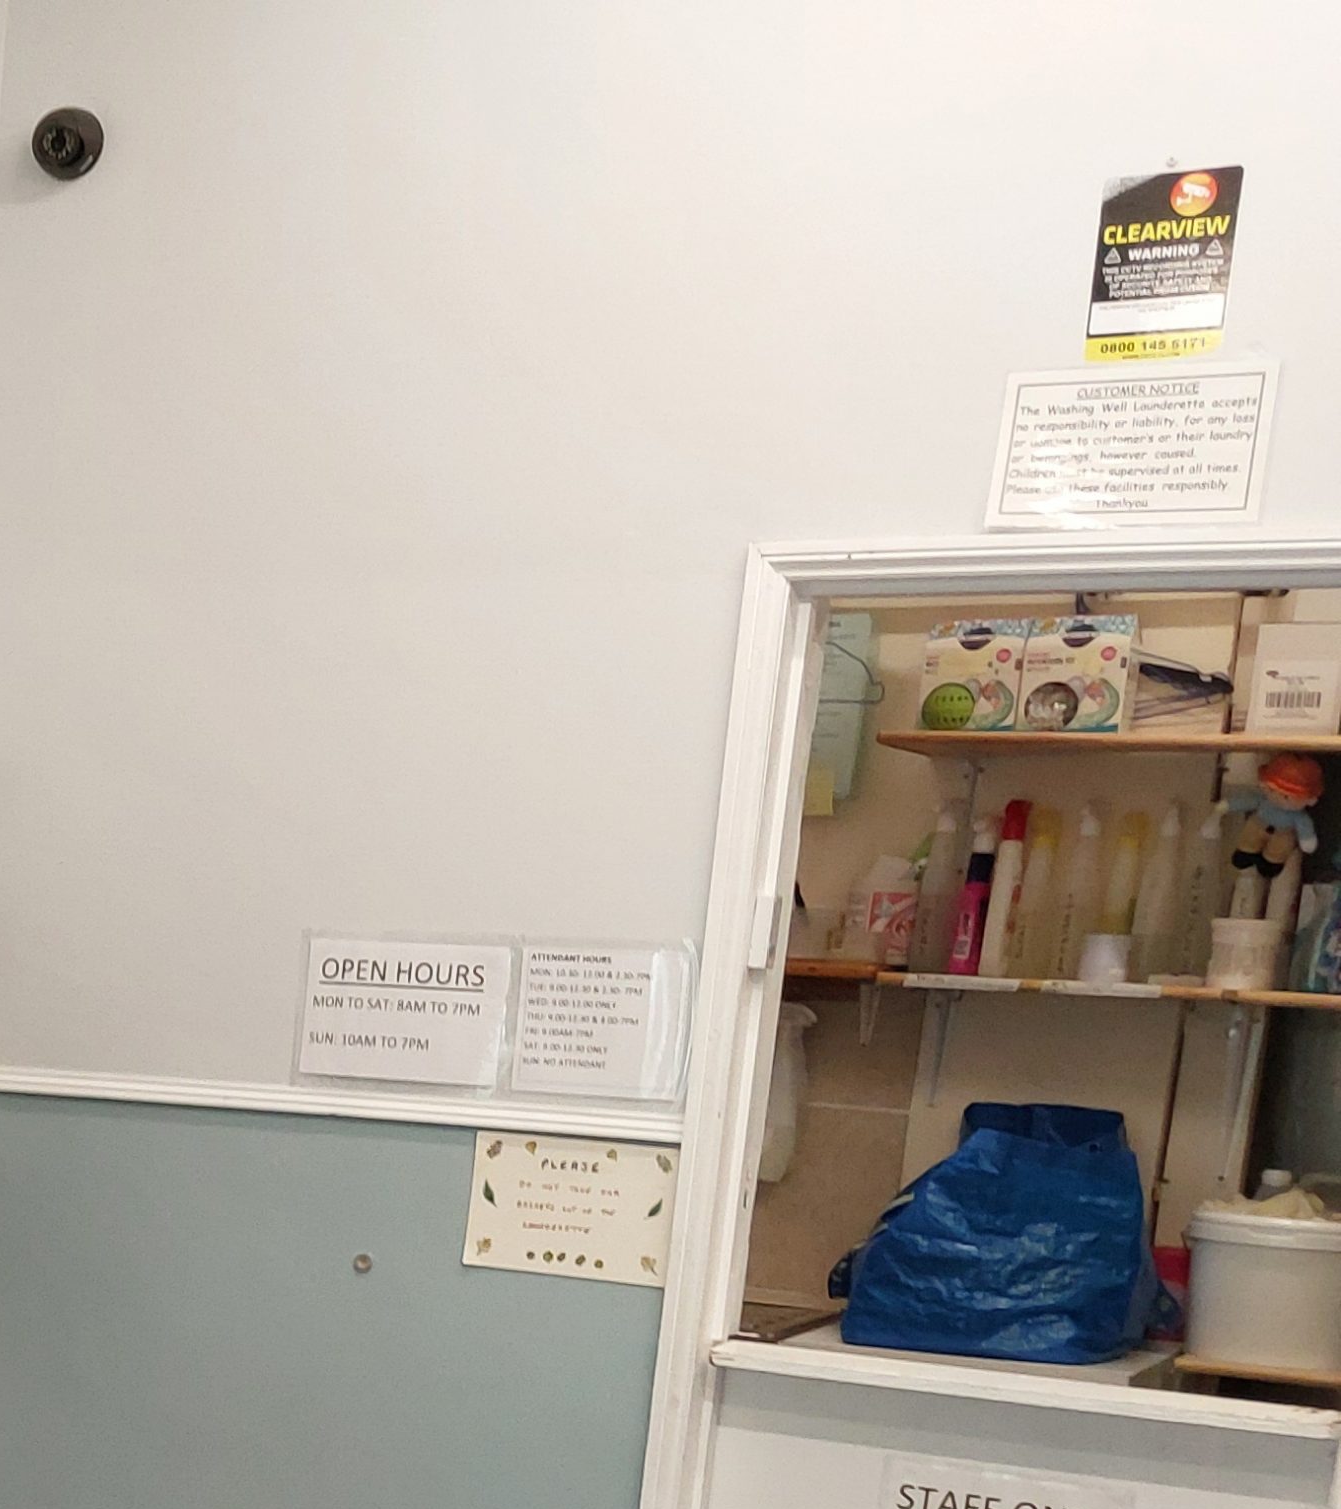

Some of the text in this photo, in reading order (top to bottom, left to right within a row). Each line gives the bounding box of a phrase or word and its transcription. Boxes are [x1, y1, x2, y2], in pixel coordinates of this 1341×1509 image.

[1103, 215, 1231, 245] CLEARVIEW
[1128, 243, 1200, 261] WARNING
[1100, 342, 1135, 353] 0800
[1077, 382, 1200, 399] CUSTOMER NOTICE
[1020, 397, 1257, 417] The Washing Well Launderette accepts
[1034, 419, 1110, 432] responsibility
[1115, 420, 1127, 428] or
[1184, 415, 1203, 425] for
[1207, 417, 1228, 426] any
[1177, 432, 1205, 441] their
[1209, 429, 1253, 442] laundry
[1100, 451, 1148, 460] however
[1109, 464, 1169, 478] supervised
[1173, 465, 1185, 474] at
[1188, 463, 1202, 474] all
[1104, 482, 1155, 493] facilities
[1162, 479, 1228, 493] responsibly
[531, 953, 612, 964] ATTENDANT HOURS
[321, 957, 485, 988] OPEN HOURS
[312, 995, 480, 1016] MON TO SAT: 8AM TO 7PM
[342, 1033, 377, 1048] 10AM
[381, 1035, 397, 1049] TO
[401, 1037, 429, 1051] 7PM
[541, 1158, 599, 1173] PLEASE
